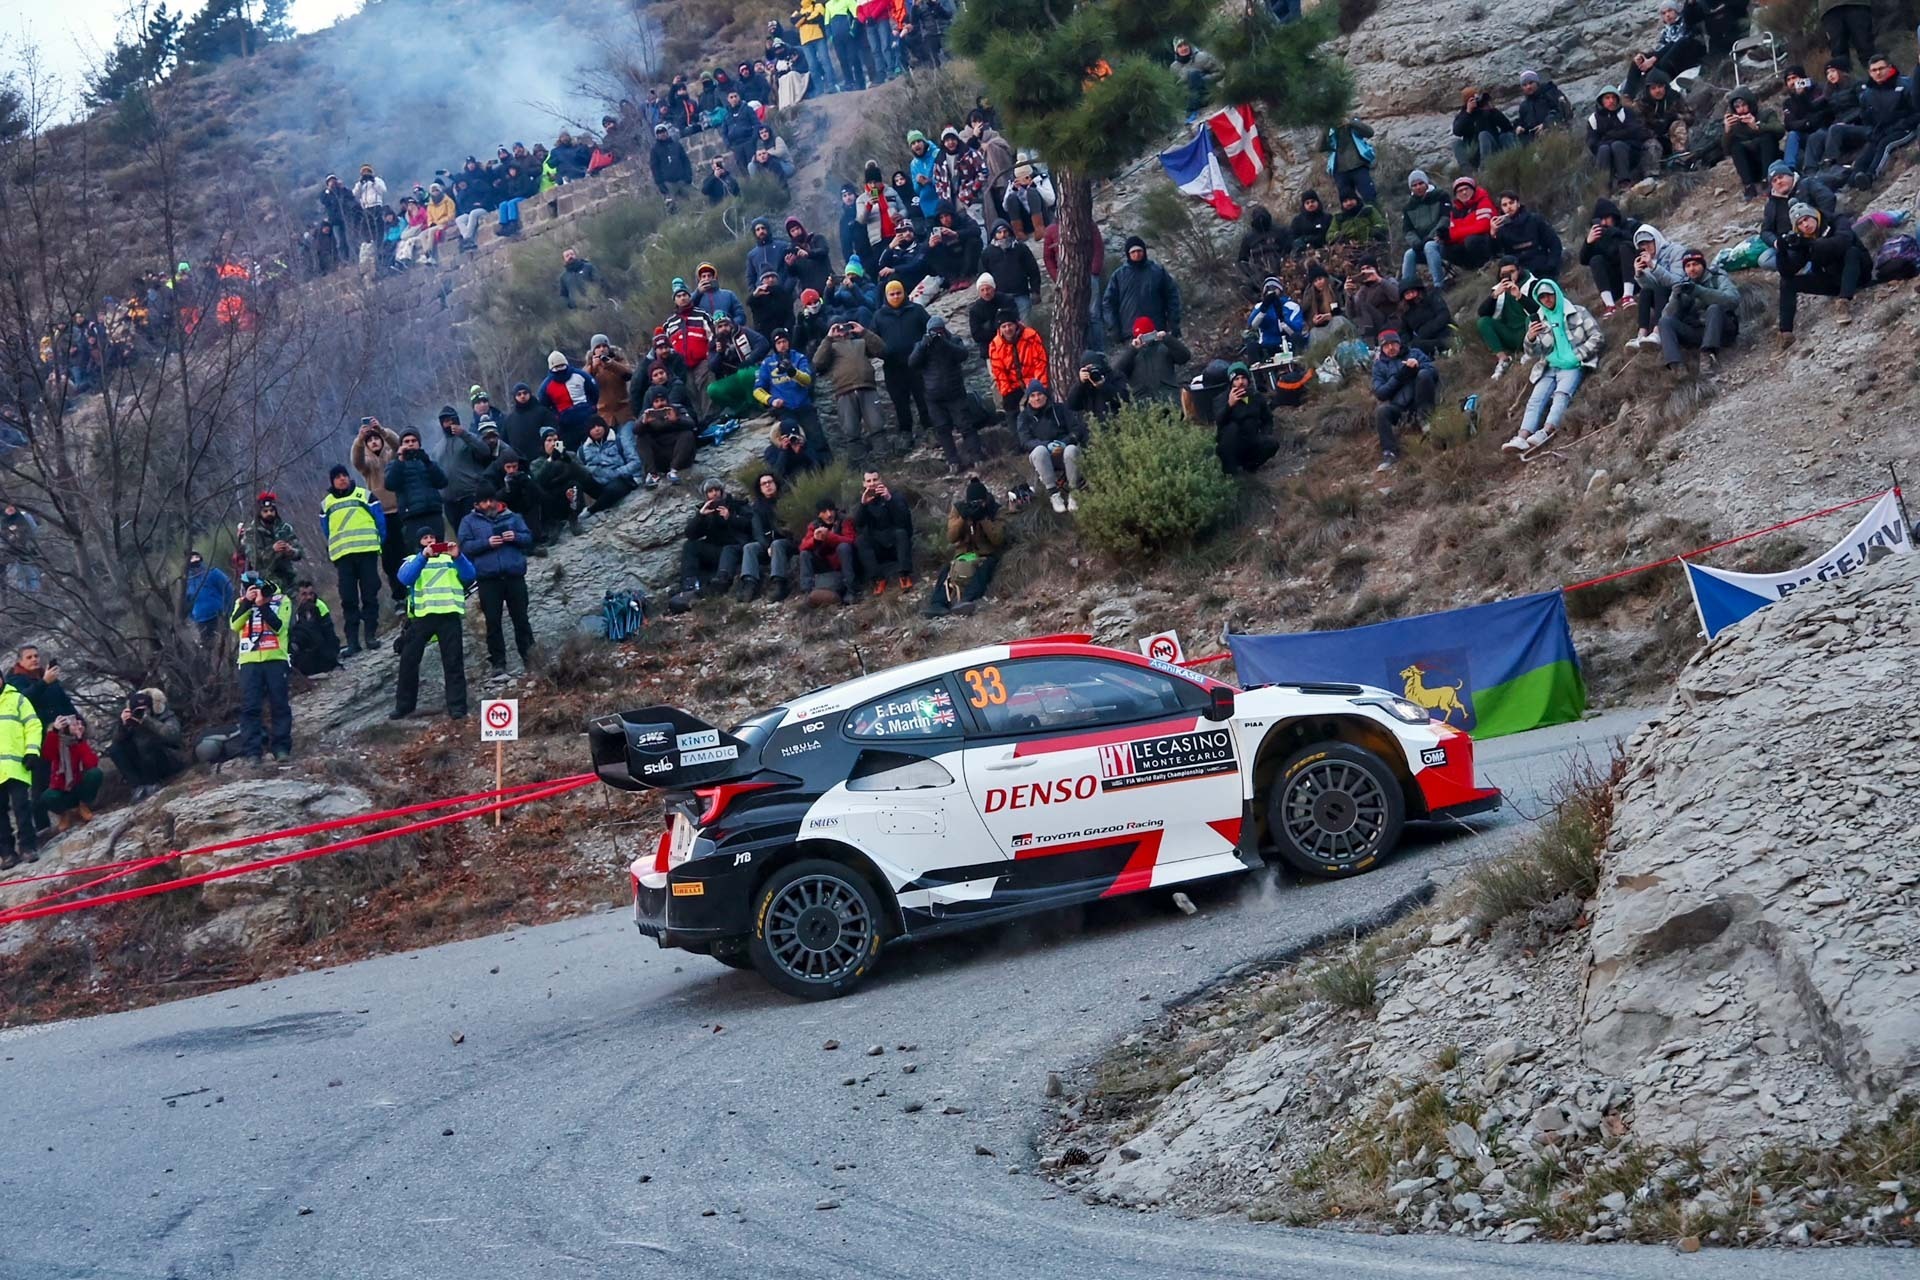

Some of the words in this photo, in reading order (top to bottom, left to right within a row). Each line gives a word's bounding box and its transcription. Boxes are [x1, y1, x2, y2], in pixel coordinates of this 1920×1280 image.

[964, 666, 1008, 709] 33
[875, 699, 926, 718] E.Evans
[874, 715, 931, 736] S.Martin
[781, 739, 821, 754] NISULA
[1134, 742, 1153, 759] LE
[1156, 732, 1228, 755] CASINO
[682, 747, 736, 763] TAMADIC
[1100, 744, 1130, 777] HY
[1423, 751, 1445, 764] OMP
[643, 757, 674, 775] Stilo
[1167, 768, 1204, 779] Championship
[984, 774, 1098, 814] DENSO
[809, 817, 839, 829] ENDLESS
[1012, 836, 1032, 847] GR
[1035, 831, 1081, 843] TOYOTA
[1083, 824, 1125, 836] GAZOO
[1126, 819, 1164, 830] Racing
[733, 851, 752, 866] JTB
